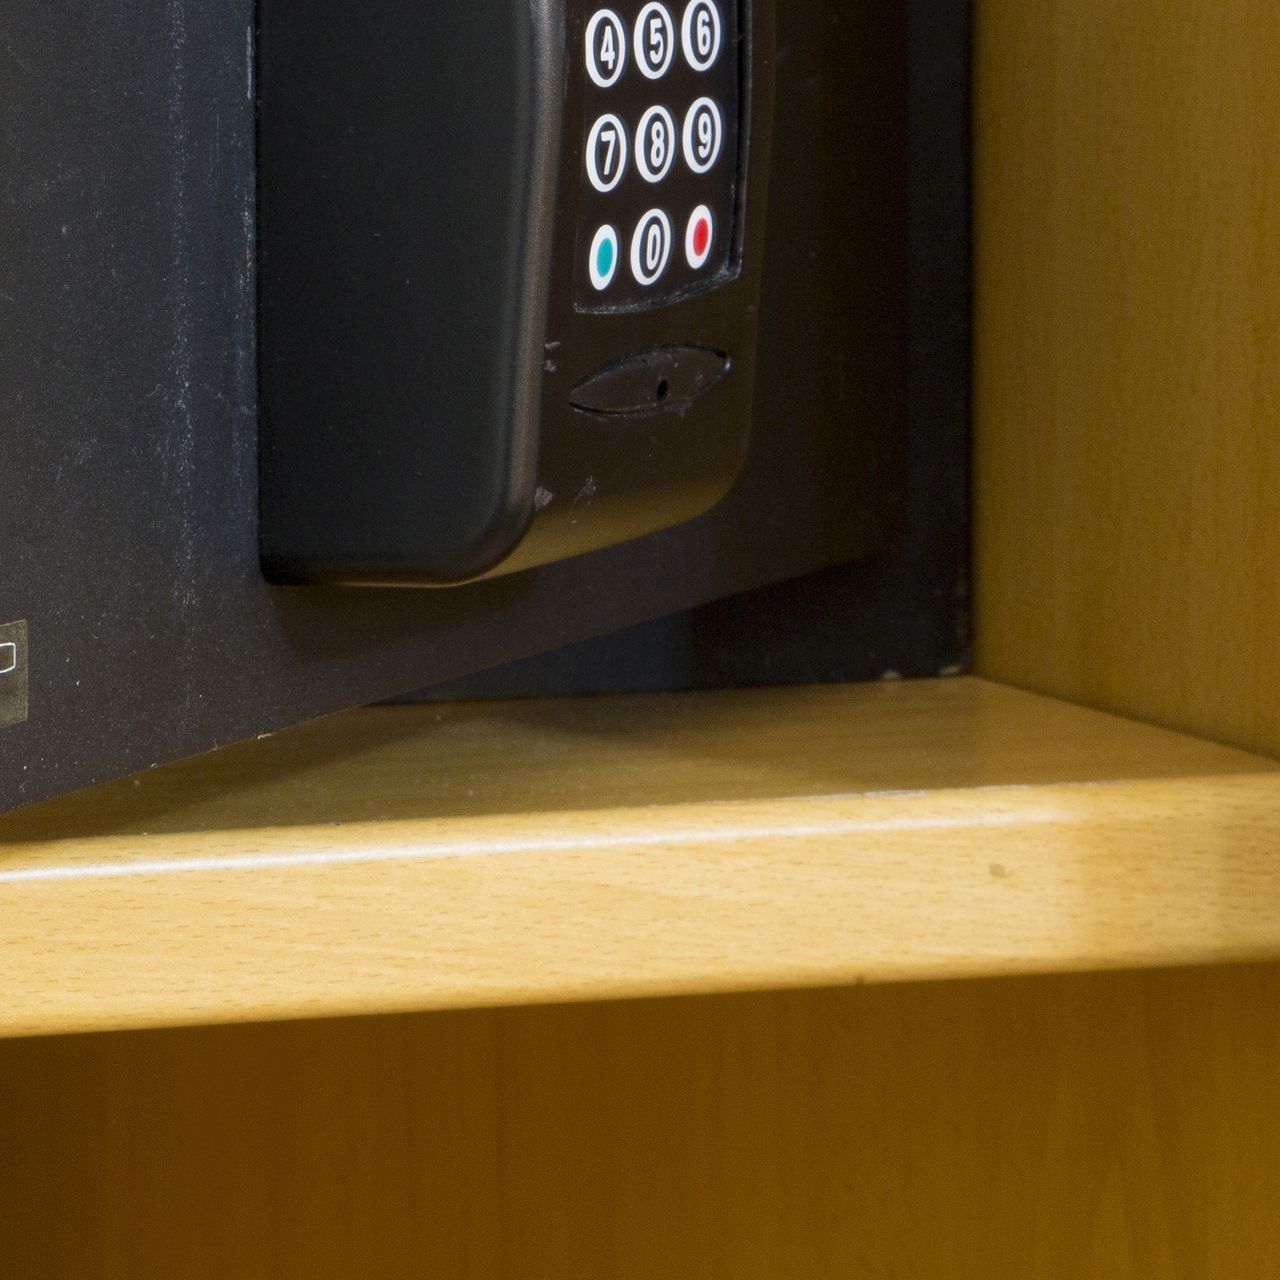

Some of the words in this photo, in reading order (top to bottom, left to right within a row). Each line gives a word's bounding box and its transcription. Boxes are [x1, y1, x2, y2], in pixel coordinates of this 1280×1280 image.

[598, 24, 617, 71] 4
[648, 16, 666, 66] 5
[695, 8, 713, 57] 6
[599, 128, 618, 177] 7
[649, 119, 667, 169] 8
[696, 111, 714, 160] 9
[644, 222, 663, 272] 0
